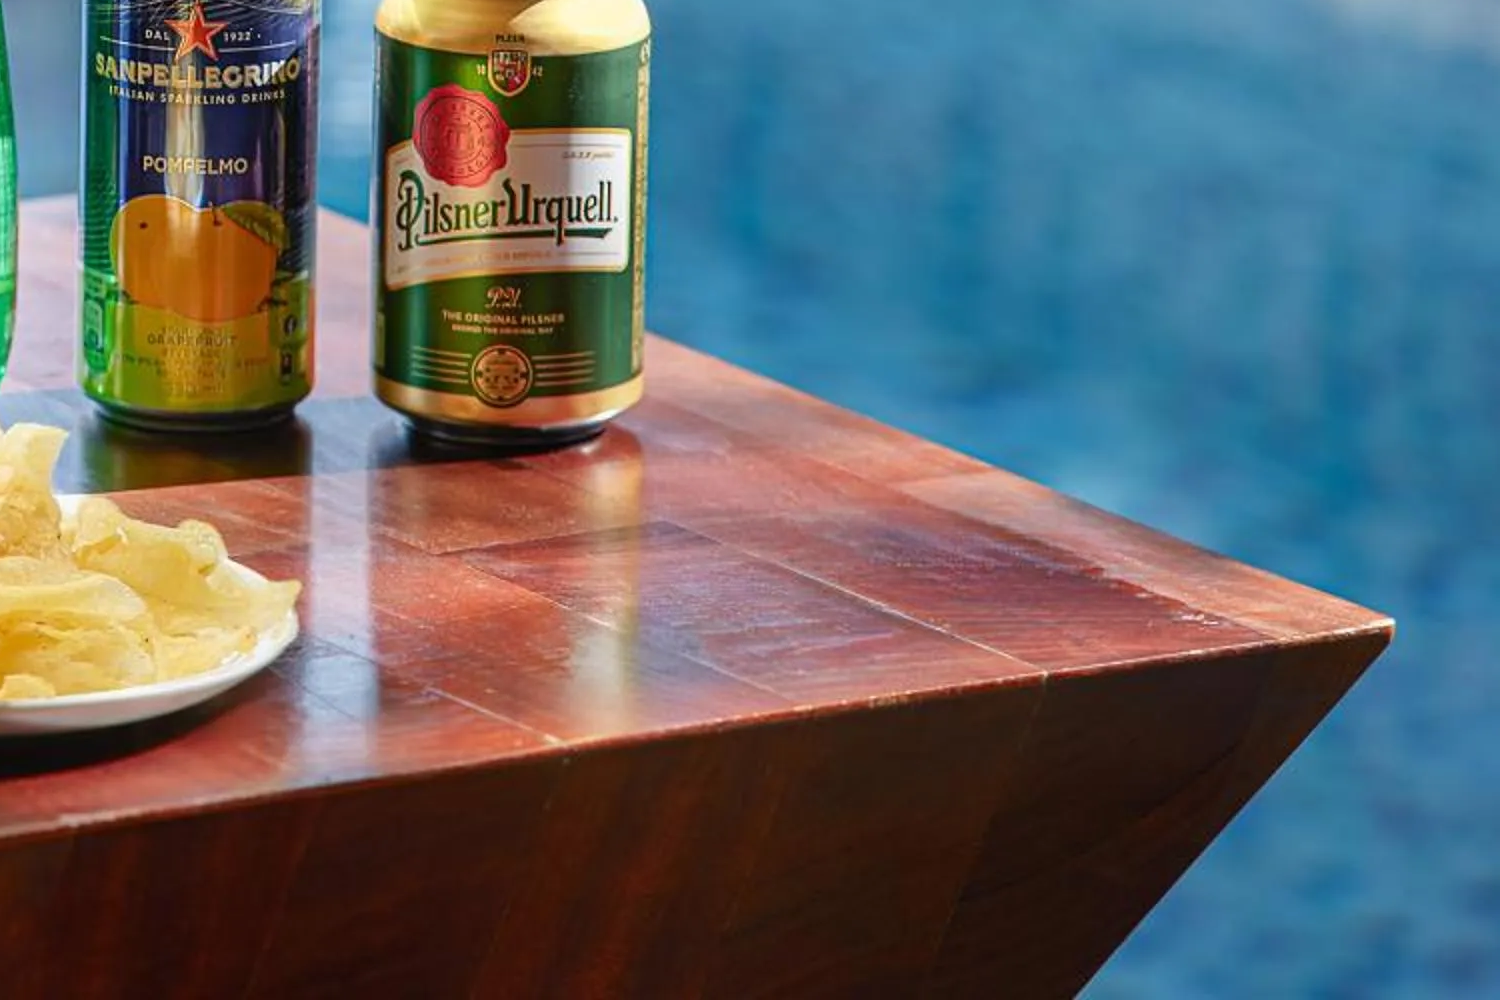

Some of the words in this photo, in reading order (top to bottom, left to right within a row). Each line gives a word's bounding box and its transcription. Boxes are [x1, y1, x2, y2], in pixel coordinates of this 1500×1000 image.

[145, 29, 170, 41] DAL
[95, 52, 301, 89] SANPELLEGRINO
[109, 85, 155, 102] ITALIAN
[161, 93, 235, 105] SPARKLING
[241, 88, 286, 103] DRINKS
[142, 155, 249, 175] POMPELMO
[396, 169, 505, 251] Pilsner
